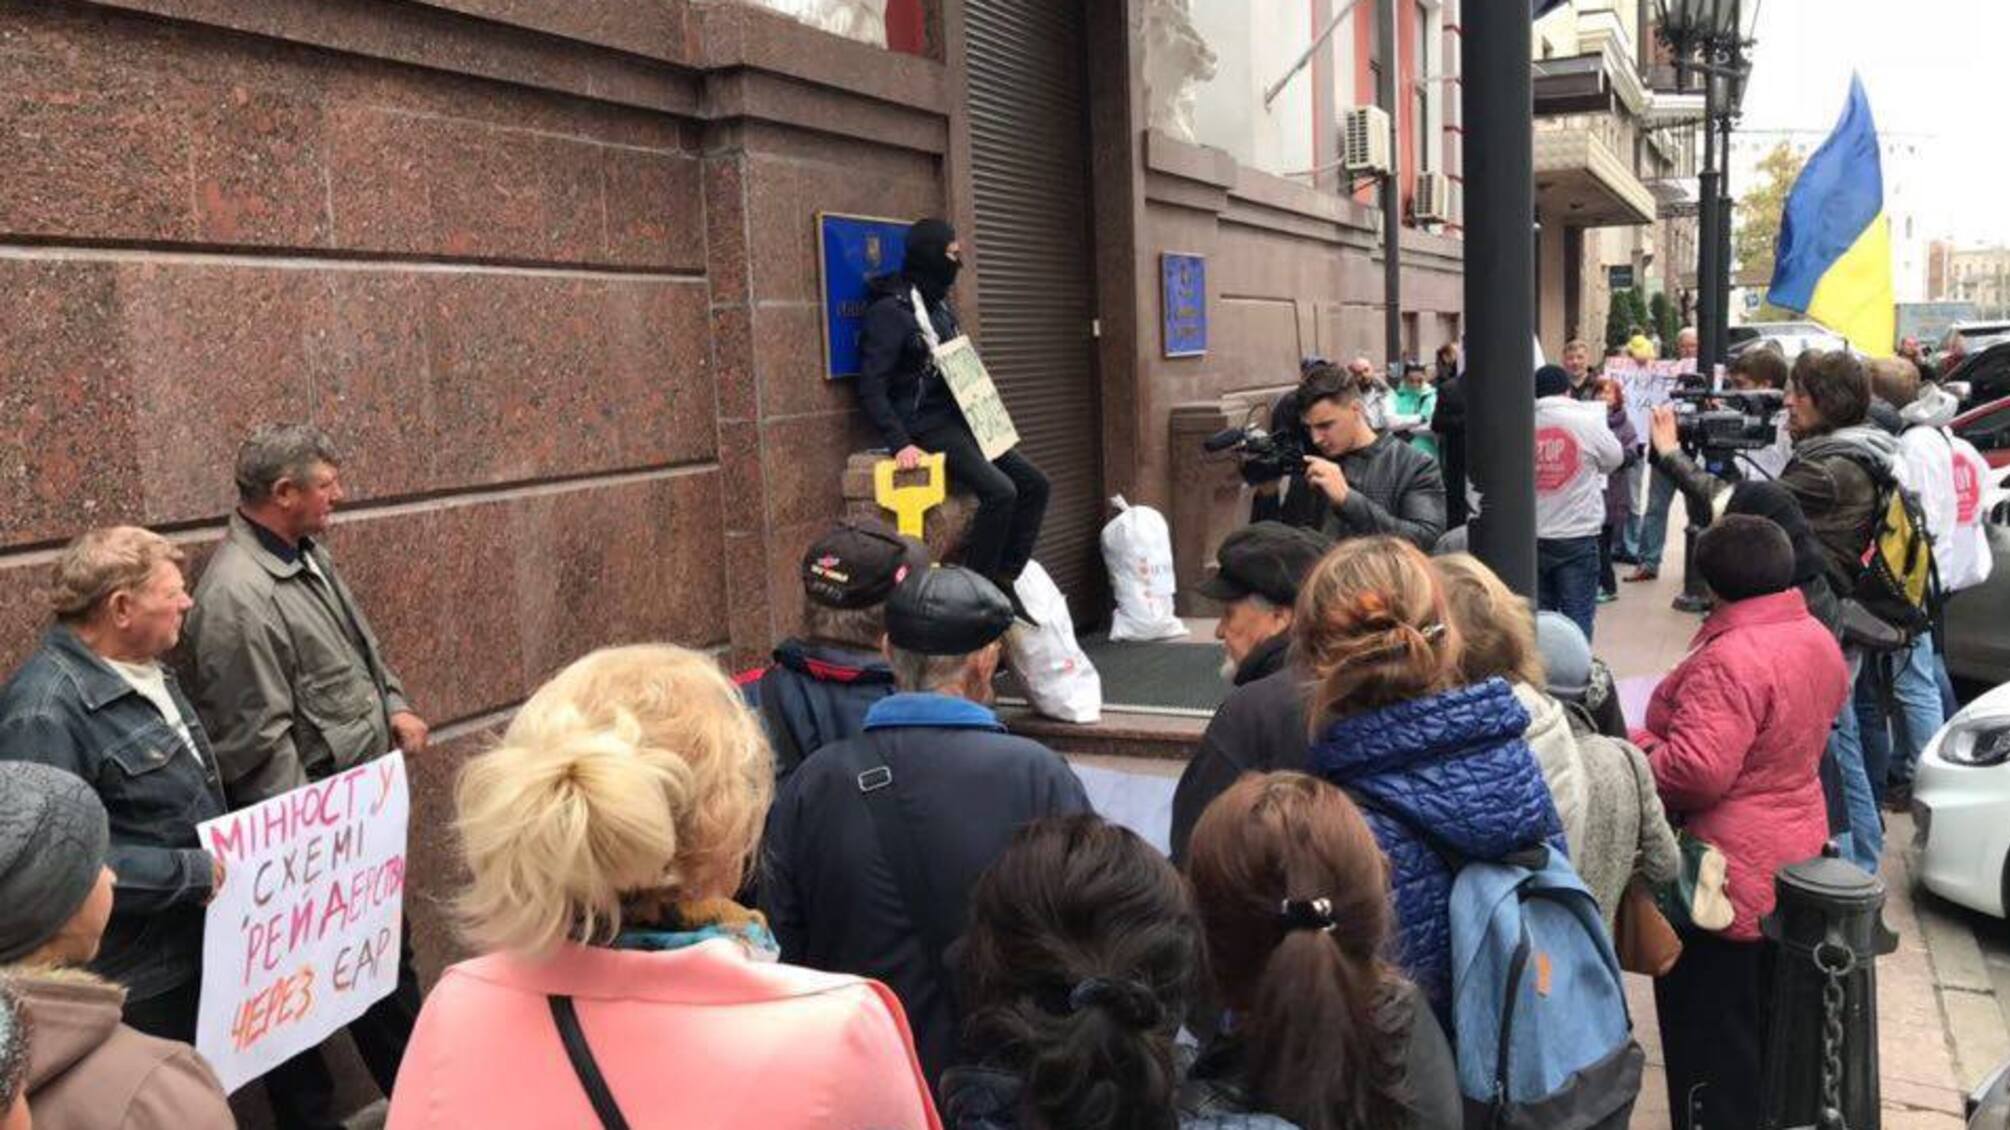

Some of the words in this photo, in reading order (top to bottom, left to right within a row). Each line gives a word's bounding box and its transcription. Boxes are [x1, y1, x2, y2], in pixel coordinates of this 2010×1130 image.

[209, 768, 366, 863] МІНЮСТ
[370, 759, 396, 816] У
[253, 818, 365, 907] СХЕМІ
[230, 964, 316, 1053] ЧЕРЕЗ
[332, 926, 392, 992] ЄАР
